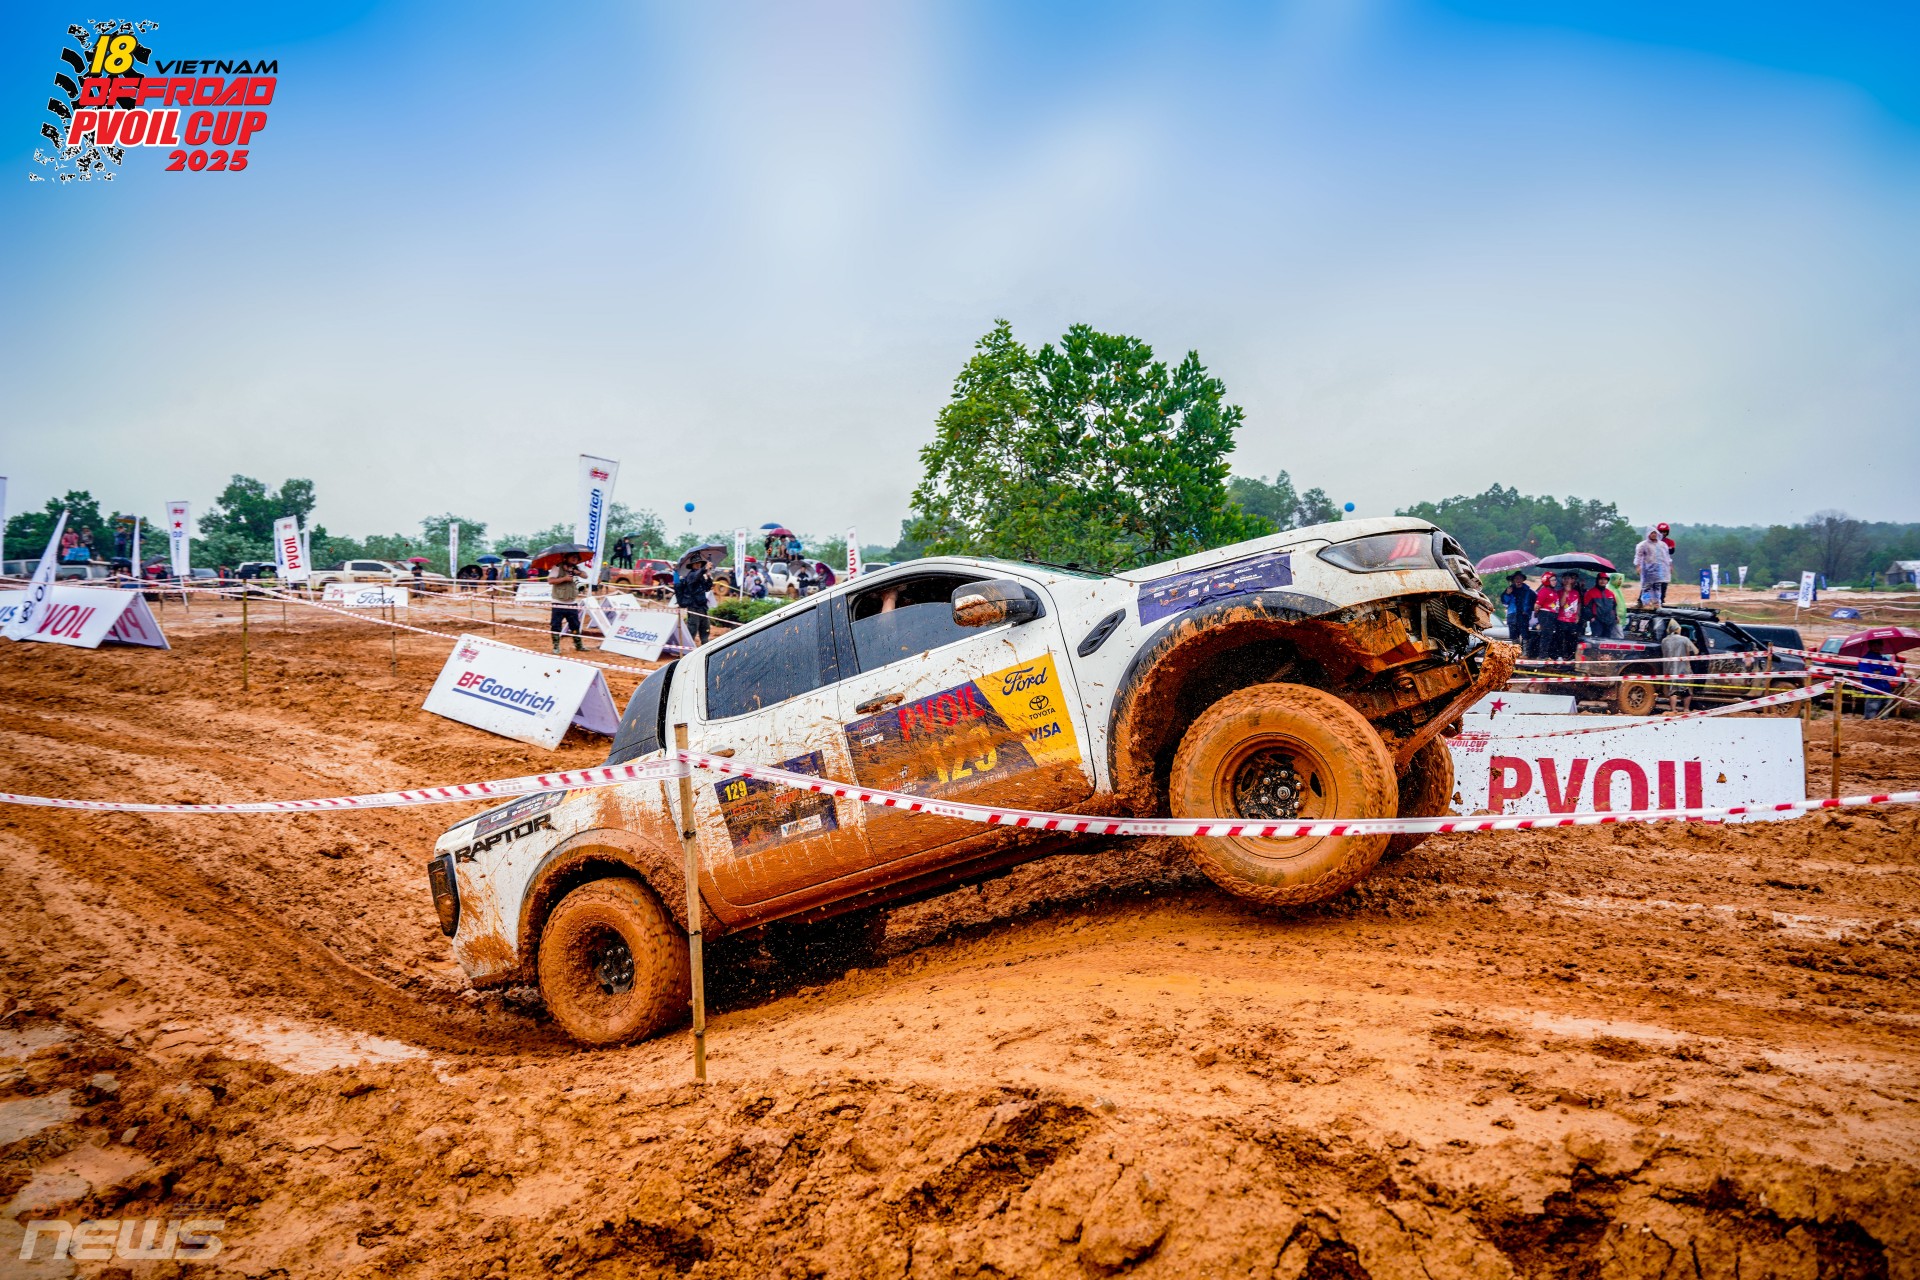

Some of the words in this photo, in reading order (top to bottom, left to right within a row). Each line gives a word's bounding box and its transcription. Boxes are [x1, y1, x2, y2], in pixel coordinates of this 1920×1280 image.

[283, 536, 301, 569] PVOIL
[356, 591, 395, 604] Ford
[38, 603, 97, 639] VOIL
[457, 671, 556, 713] BFGoodrich
[1002, 666, 1048, 696] Ford
[898, 686, 986, 742] PVOIL
[1029, 707, 1056, 720] TOYOTA
[1029, 722, 1062, 742] VISA
[725, 780, 748, 801] 129
[455, 814, 558, 863] RAPTOR
